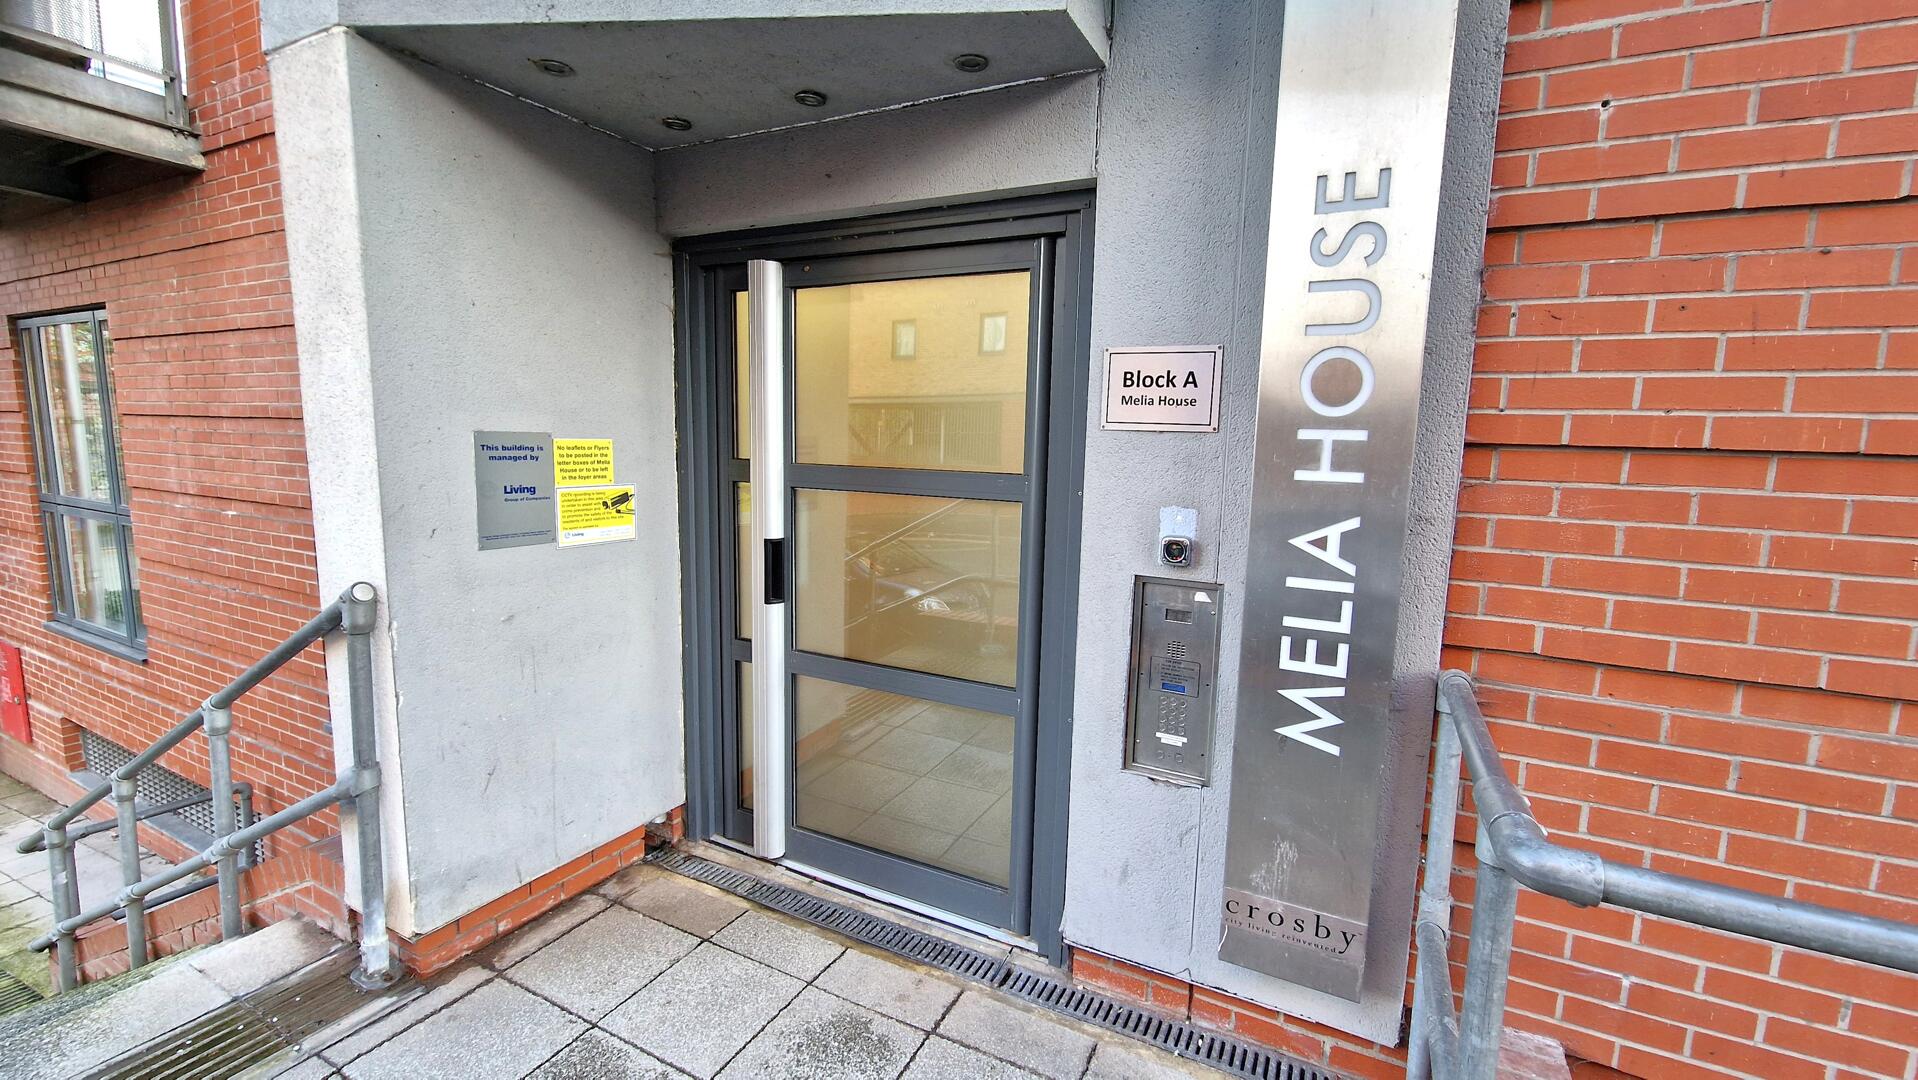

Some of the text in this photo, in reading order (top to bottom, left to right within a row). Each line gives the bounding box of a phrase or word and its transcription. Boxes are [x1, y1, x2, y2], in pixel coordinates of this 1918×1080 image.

[1123, 370, 1198, 388] Block A
[1121, 395, 1197, 407] Melia House
[501, 444, 535, 452] building
[488, 454, 540, 462] managed by
[1272, 167, 1393, 756] MELIA HOUSE
[503, 485, 536, 495] Living
[1225, 900, 1360, 954] crosby
[1281, 934, 1337, 953] reinvented
